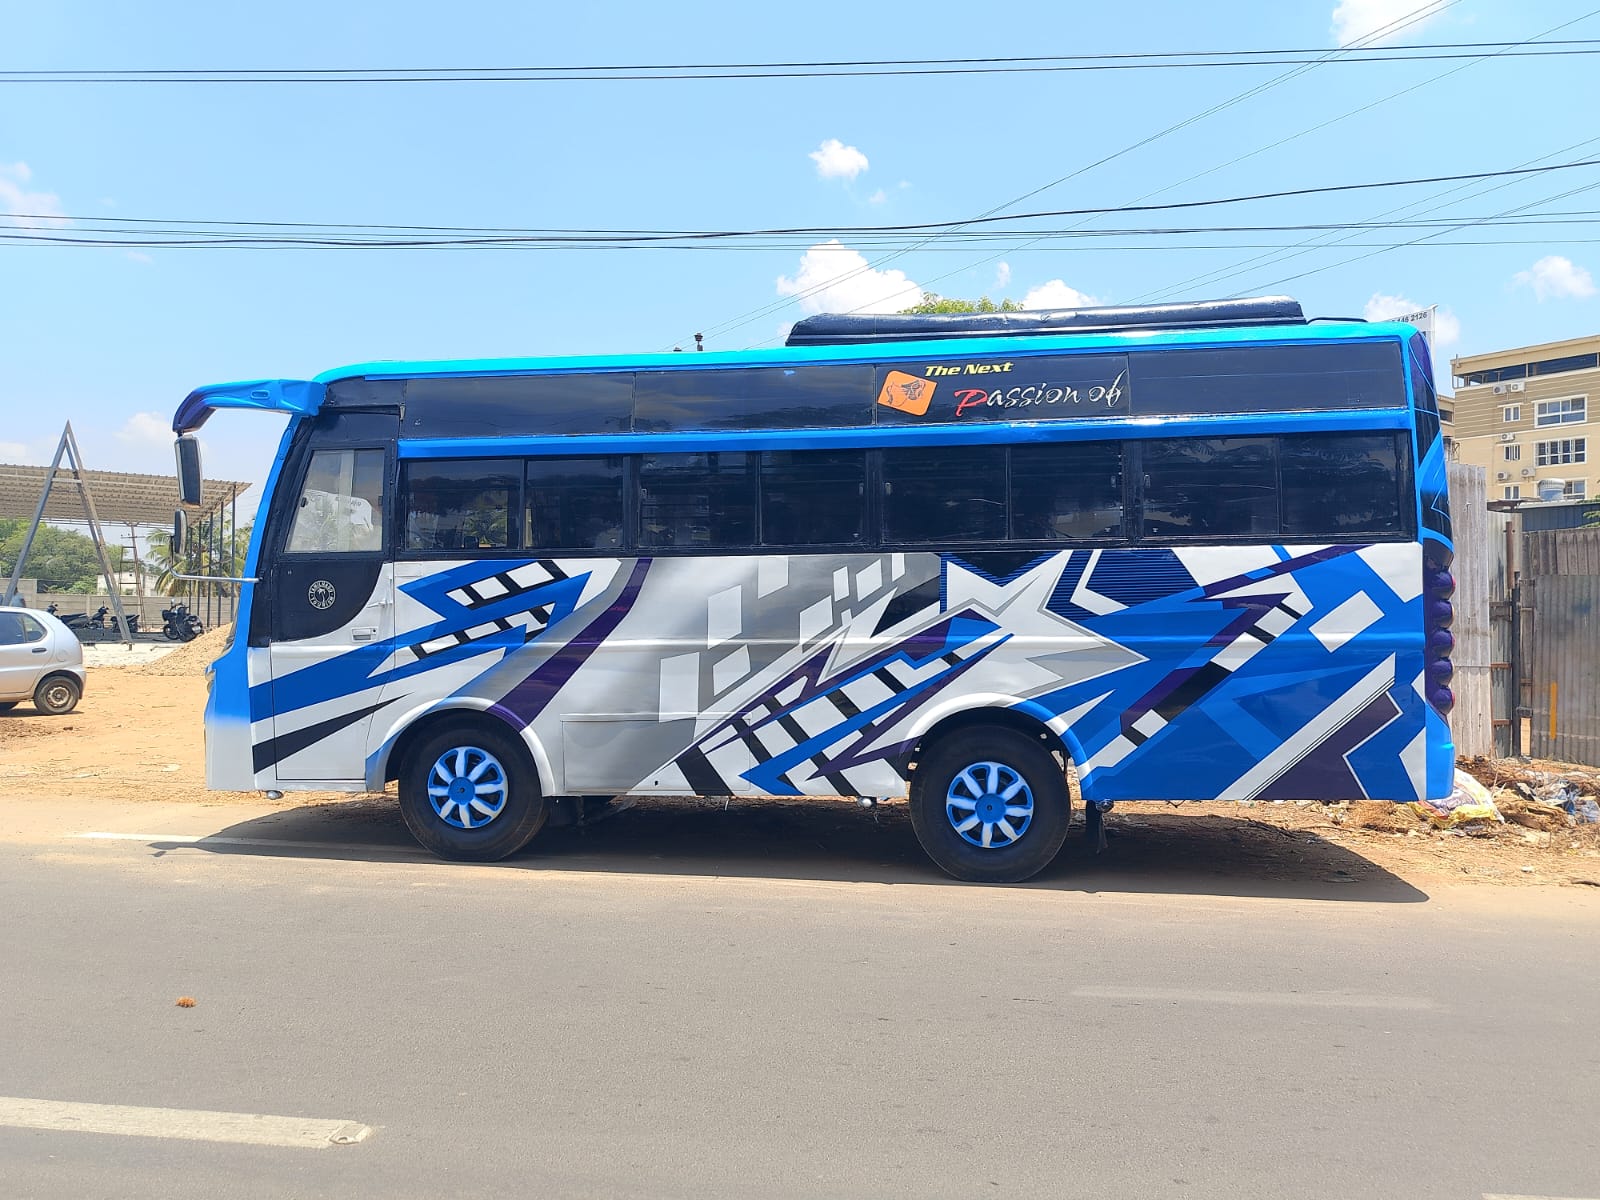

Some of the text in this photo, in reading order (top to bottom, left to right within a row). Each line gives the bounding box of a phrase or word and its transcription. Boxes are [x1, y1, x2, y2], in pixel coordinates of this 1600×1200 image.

[924, 361, 1014, 377] The Next
[954, 382, 1082, 417] Passion
